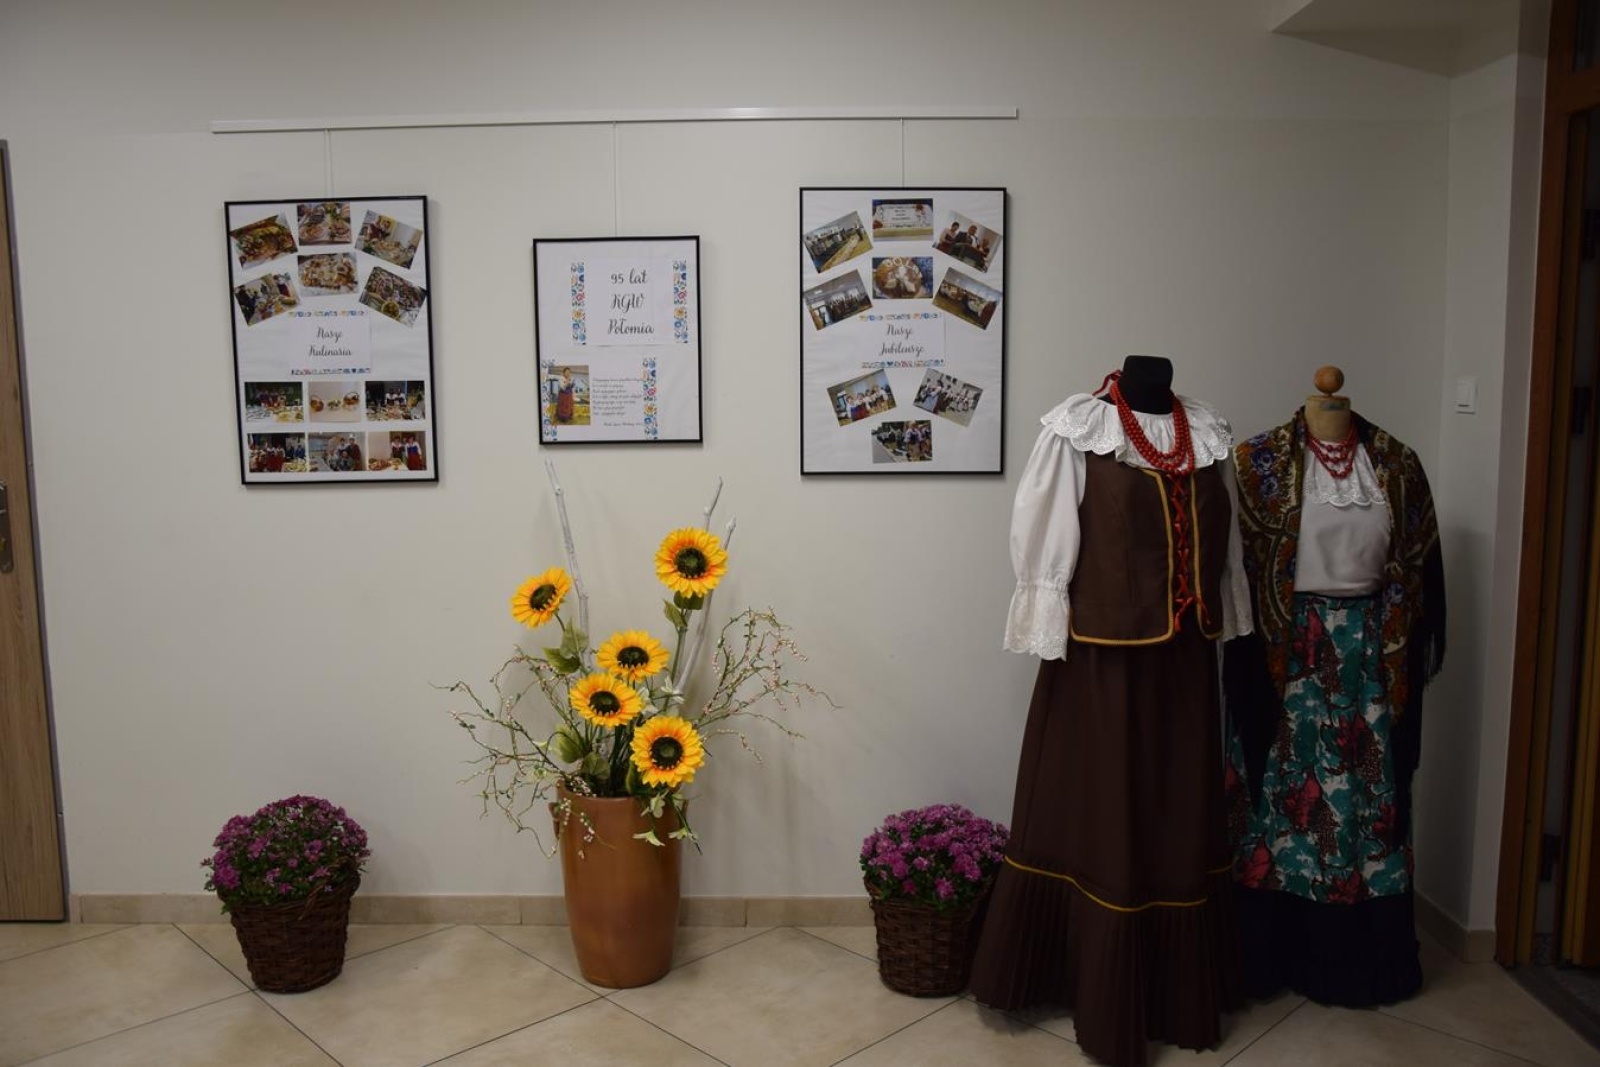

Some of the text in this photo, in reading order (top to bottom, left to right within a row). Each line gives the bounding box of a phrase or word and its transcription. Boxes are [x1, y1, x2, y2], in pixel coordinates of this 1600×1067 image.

[610, 267, 647, 285] 95 lat
[611, 292, 645, 313] KGW
[316, 326, 342, 343] Nasze
[607, 317, 655, 335] Połomia
[885, 323, 913, 340] Nasze
[308, 344, 352, 357] Kulinaria
[879, 341, 924, 357] Jubileusze
